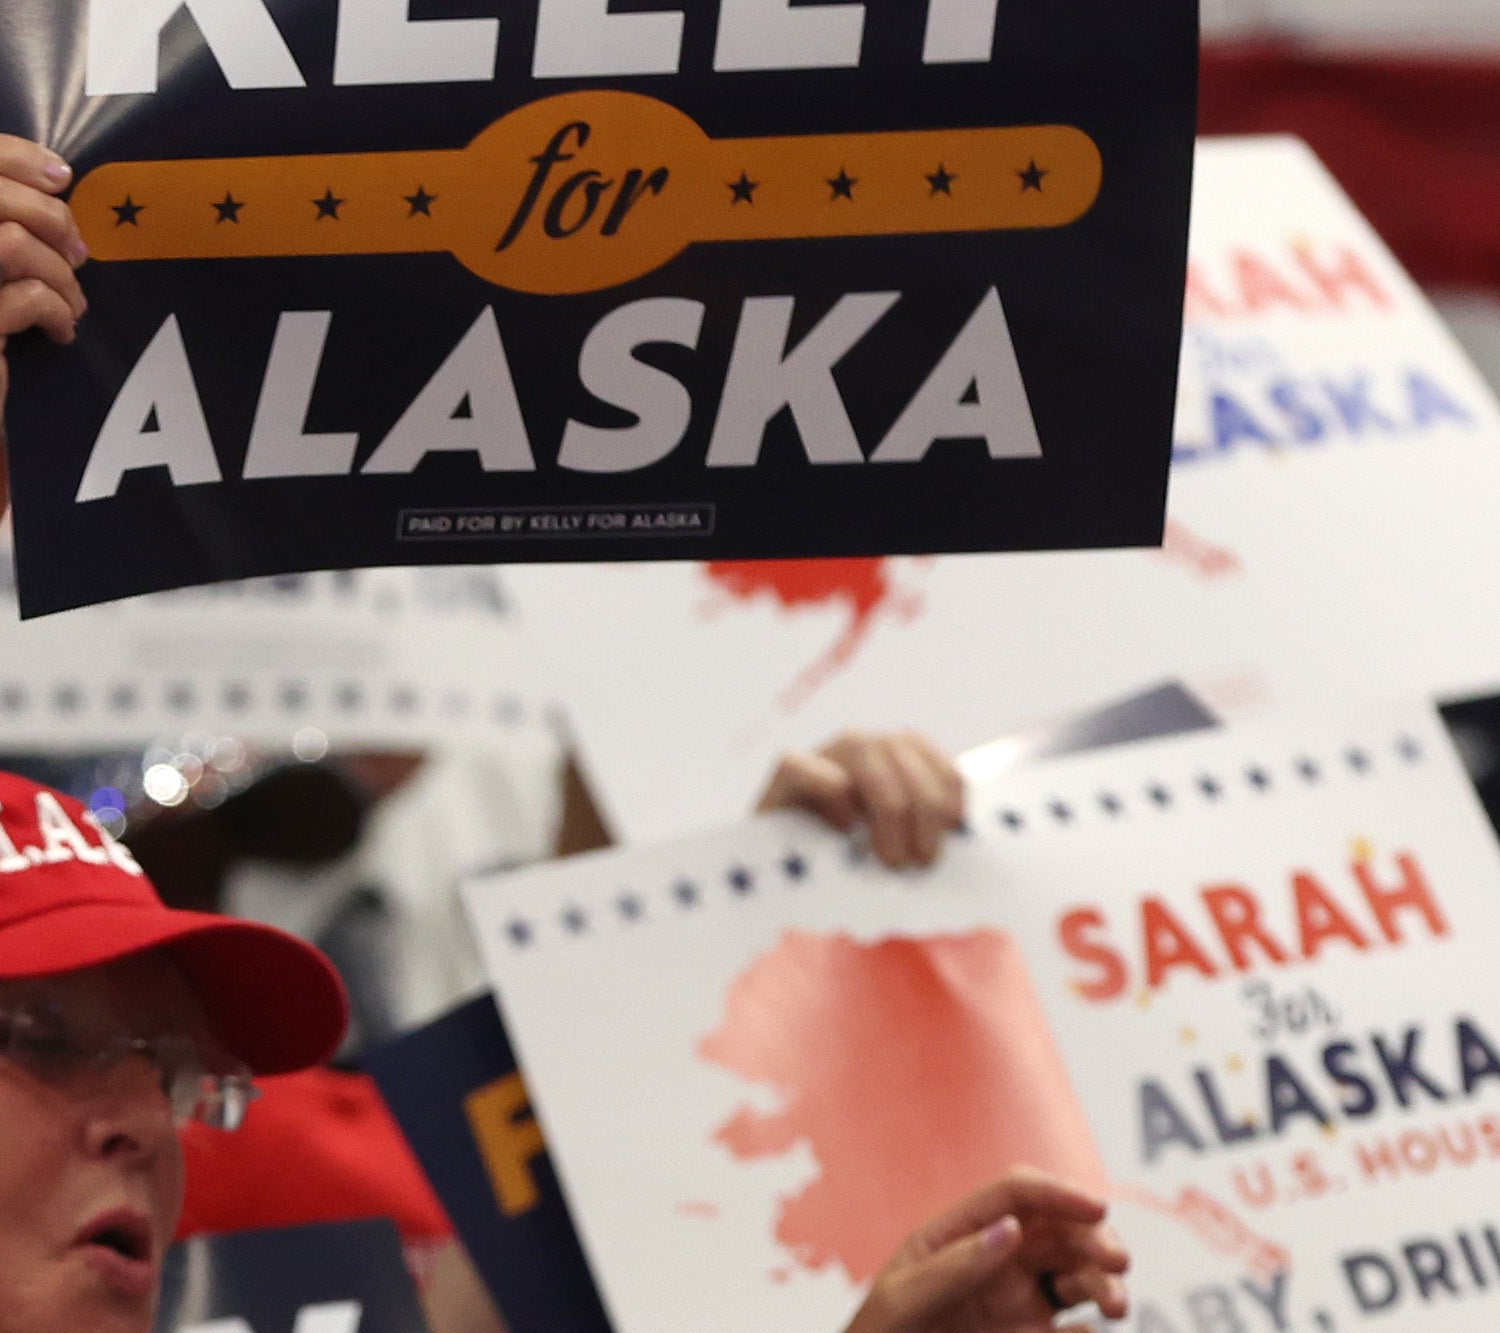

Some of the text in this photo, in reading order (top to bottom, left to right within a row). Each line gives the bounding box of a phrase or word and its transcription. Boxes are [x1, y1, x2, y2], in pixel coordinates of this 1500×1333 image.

[494, 121, 670, 253] for
[75, 285, 1044, 504] ALASKA
[1057, 852, 1452, 1005] SARAH
